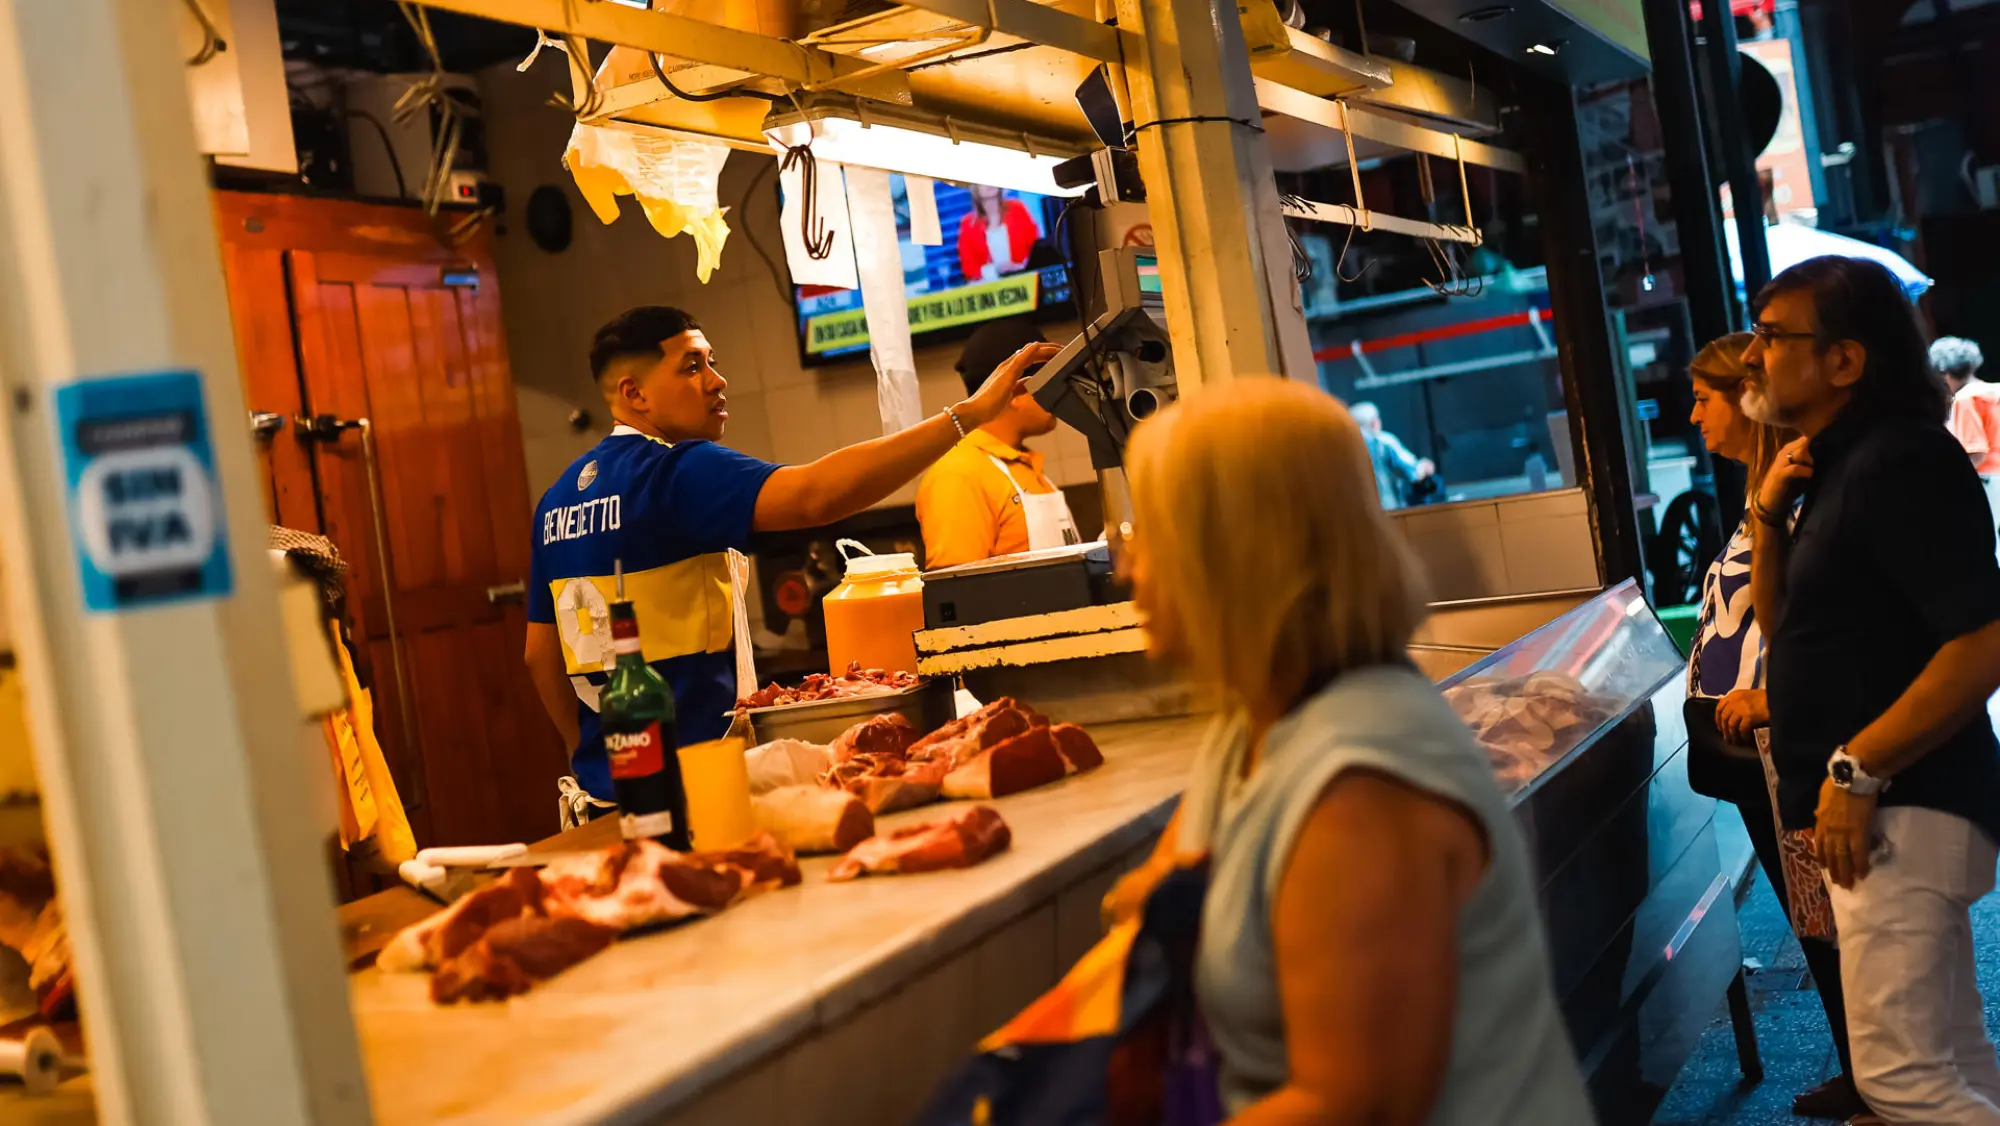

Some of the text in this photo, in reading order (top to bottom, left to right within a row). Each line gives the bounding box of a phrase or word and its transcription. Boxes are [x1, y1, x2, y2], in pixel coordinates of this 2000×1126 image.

[103, 467, 183, 503] SIN
[108, 513, 194, 553] IVA
[543, 494, 621, 546] BENEDETTO
